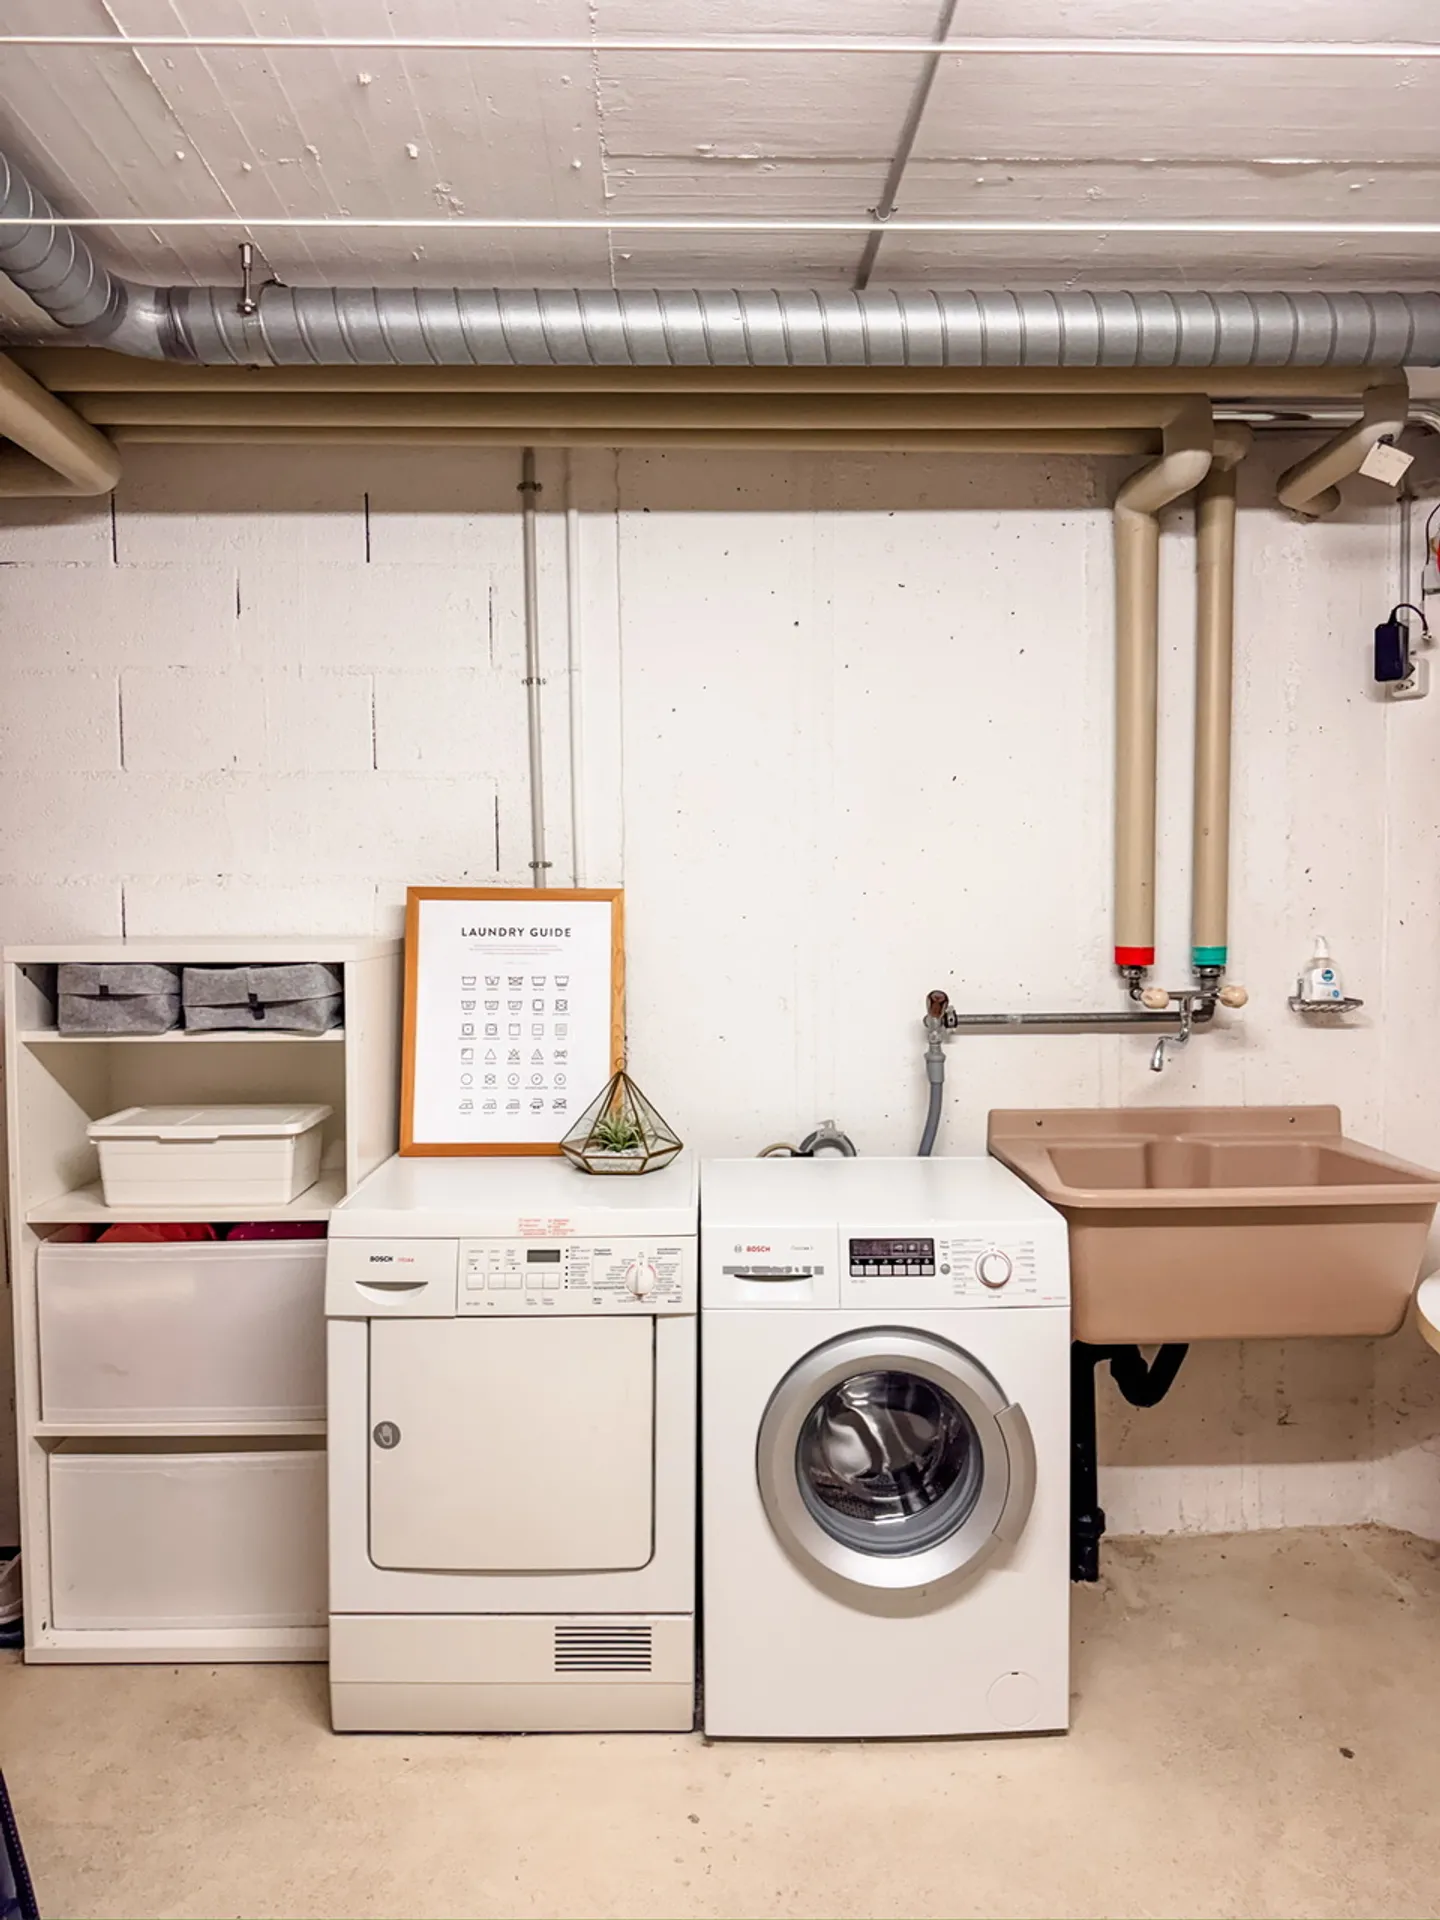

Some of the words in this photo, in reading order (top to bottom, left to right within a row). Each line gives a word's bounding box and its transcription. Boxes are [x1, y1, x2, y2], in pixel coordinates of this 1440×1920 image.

[461, 927, 524, 937] LAUNDRY
[530, 927, 571, 938] GUIDE
[745, 1245, 771, 1253] BOSCH
[369, 1255, 393, 1263] BOSCH
